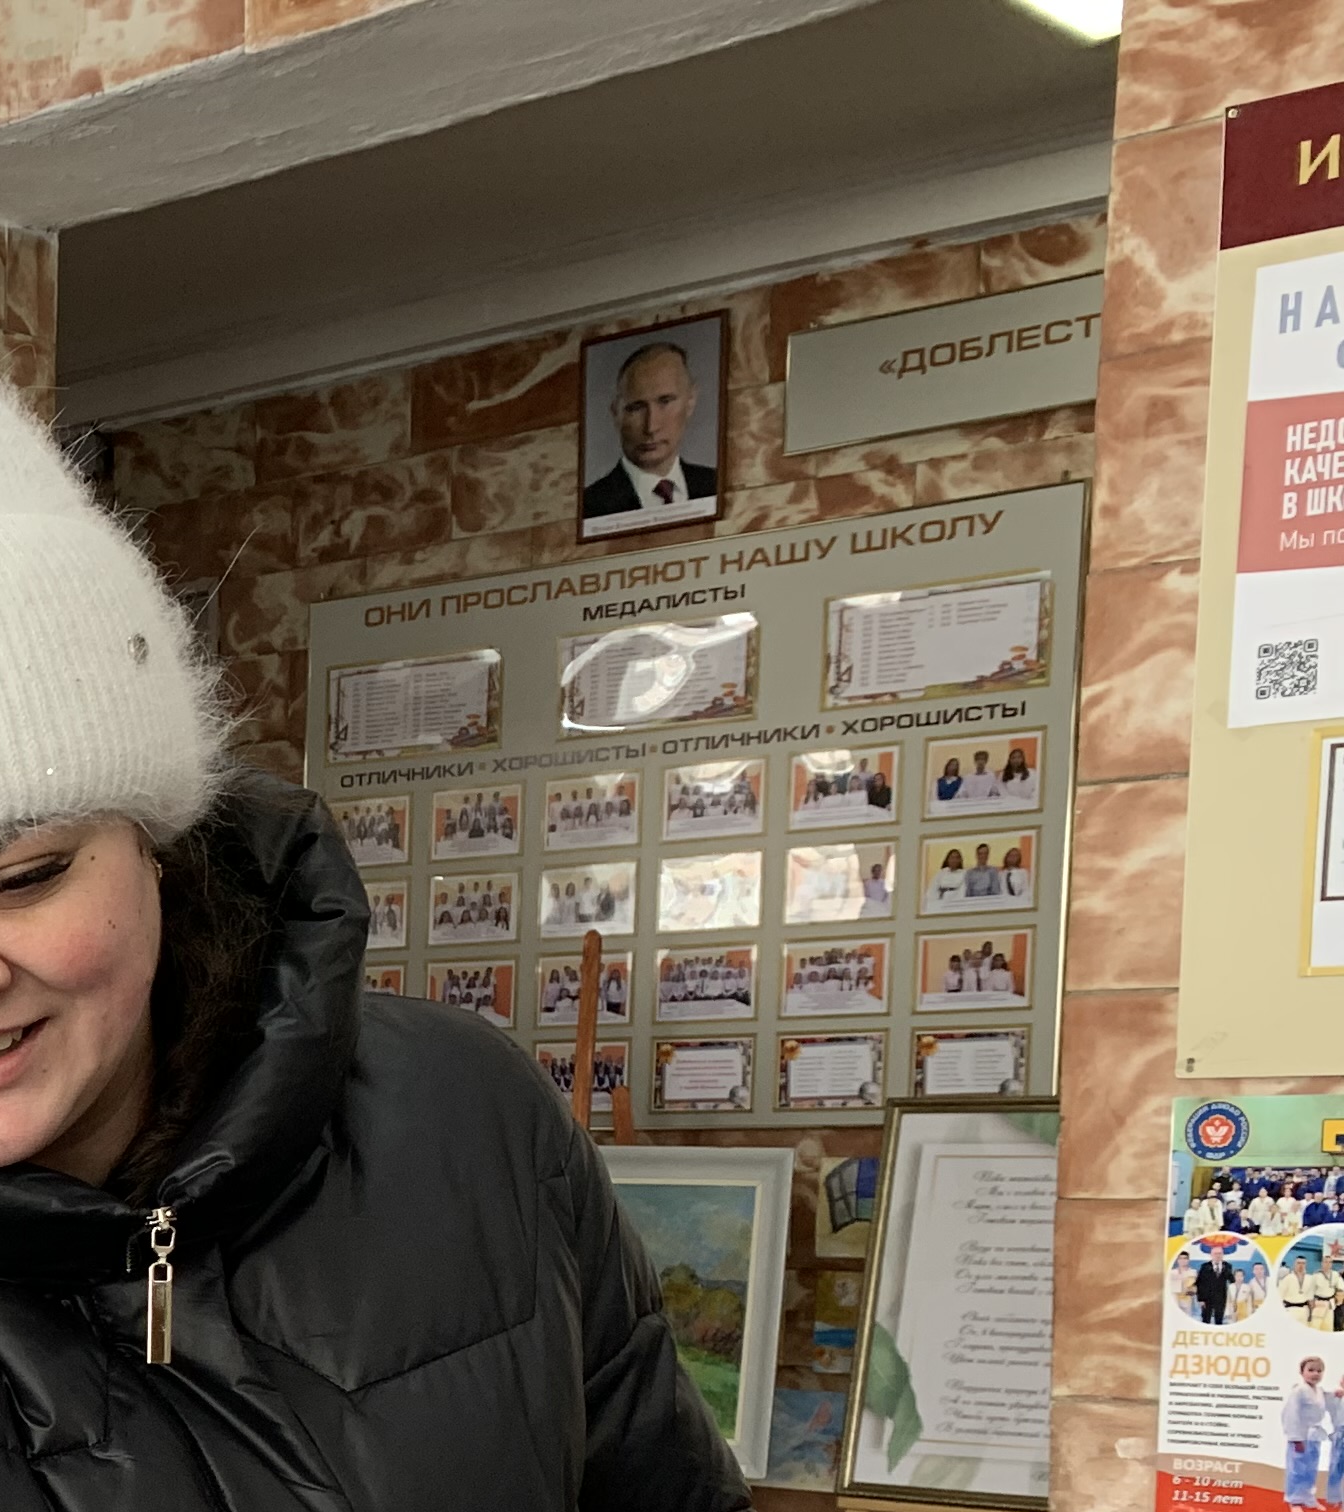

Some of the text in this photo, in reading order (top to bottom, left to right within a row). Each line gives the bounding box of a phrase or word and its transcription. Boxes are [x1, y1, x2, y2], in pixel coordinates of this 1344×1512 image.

[1282, 492, 1298, 519] В
[1280, 529, 1315, 552] Мы
[364, 510, 1005, 628] ОНИ ПРОСЛАВЛЯЮТ НАШУ ШКОЛУ
[583, 583, 746, 622] МЕДАЛИСТЫ
[340, 700, 1026, 788] ОТЛИЧНИКИ ХОРОШИСТЫ ОТЛИЧНИКИ ХОРОШИСТЫ
[1172, 1330, 1266, 1349] ДЕТСКОЕ
[1169, 1353, 1271, 1382] ДЗЮДО
[1173, 1458, 1243, 1473] ВОЗРАСТ
[1172, 1475, 1181, 1485] 6
[1193, 1475, 1211, 1487] 10
[1212, 1479, 1244, 1489] лет
[1172, 1489, 1244, 1505] 11-15 лет
